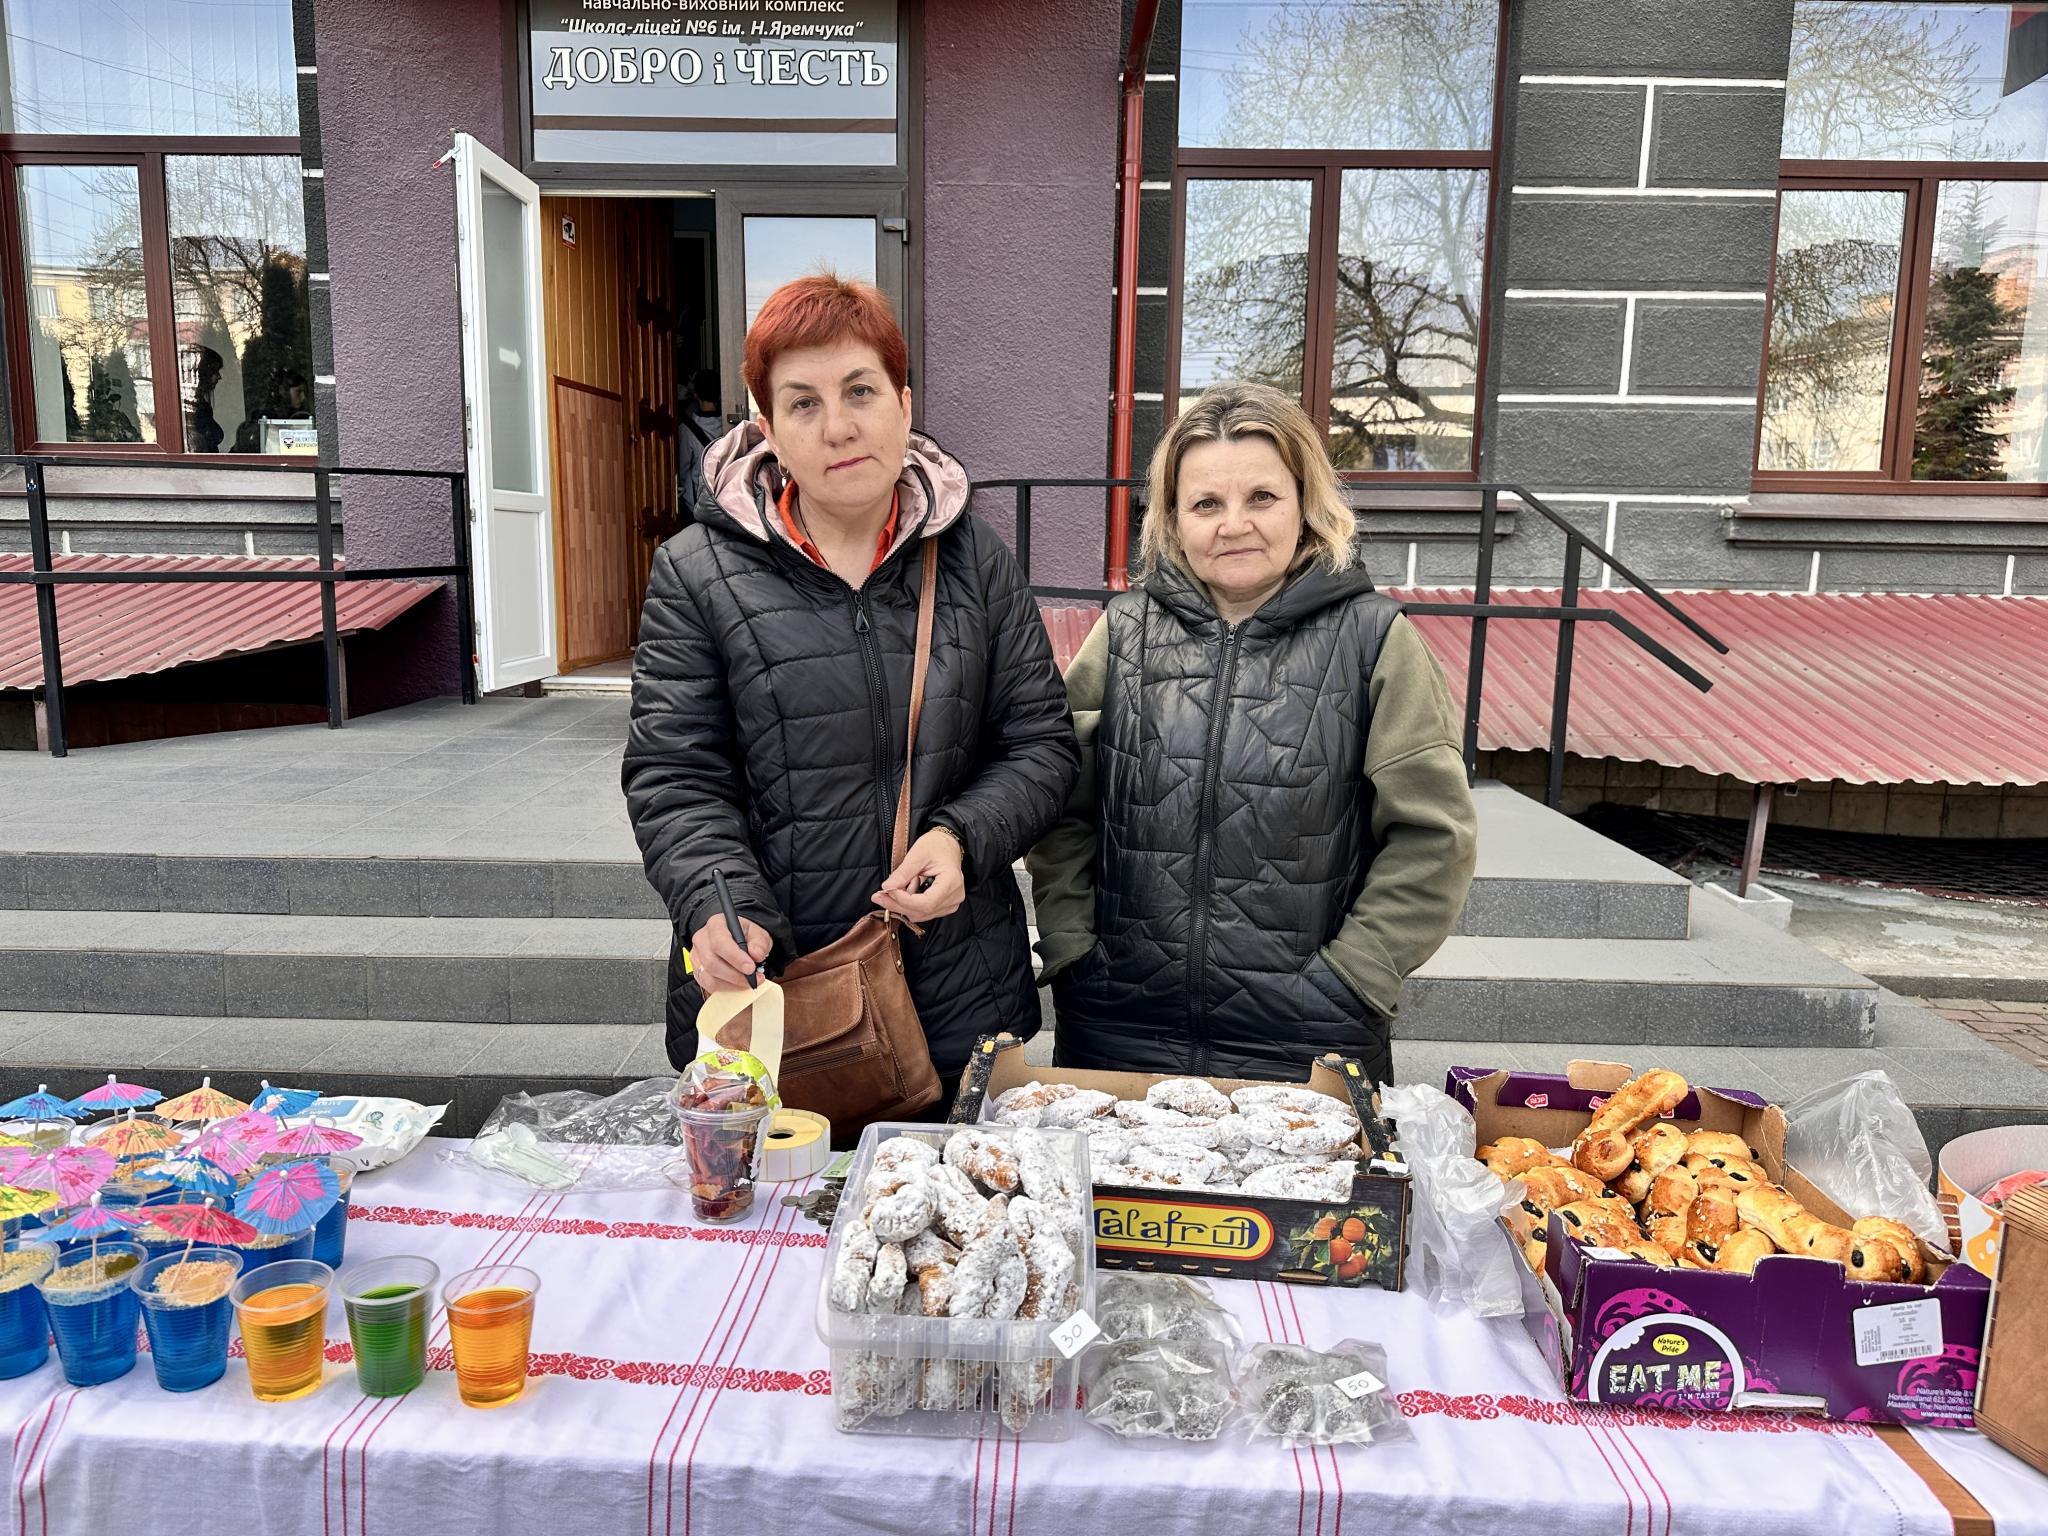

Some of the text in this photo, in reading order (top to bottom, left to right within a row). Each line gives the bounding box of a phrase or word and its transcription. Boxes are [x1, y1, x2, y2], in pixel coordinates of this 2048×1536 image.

[765, 0, 845, 12] комплекс
[685, 19, 718, 35] №6
[722, 20, 745, 35] ім.
[542, 46, 889, 91] ДОБРО і ЧЕСТЬ
[1061, 1324, 1082, 1349] 30
[1657, 1337, 1685, 1346] Nature's
[1661, 1345, 1680, 1353] Pride
[1609, 1360, 1721, 1394] EAT ME
[1348, 1379, 1369, 1391] 50
[1695, 1391, 1721, 1399] TASTY
